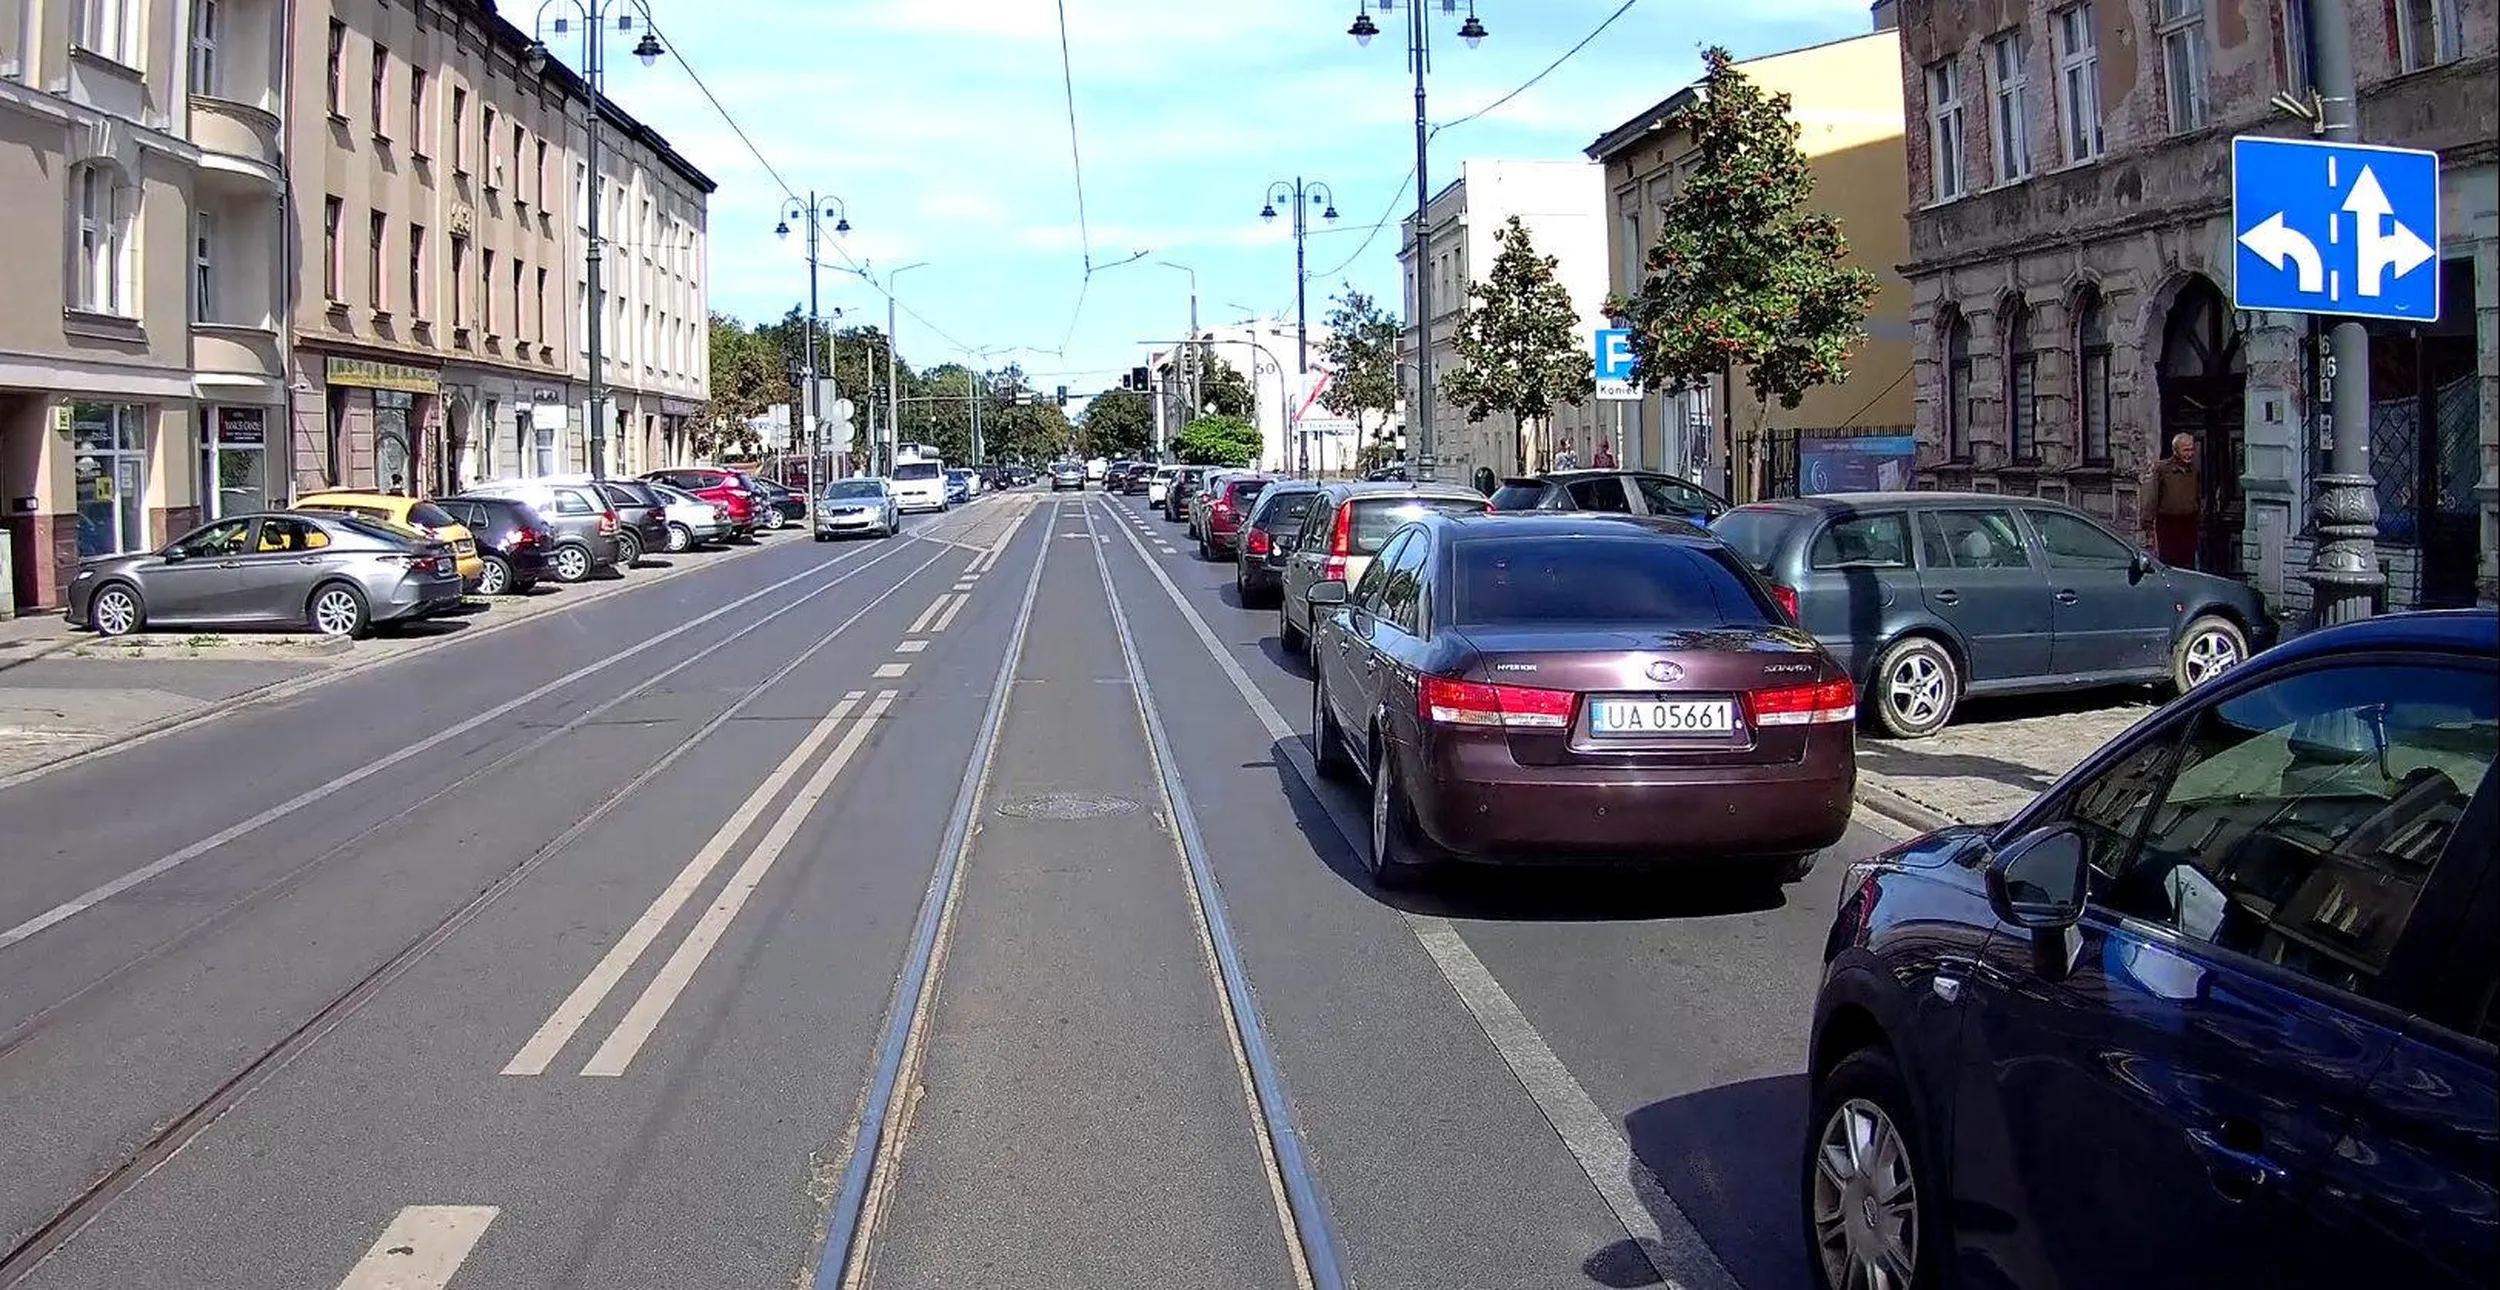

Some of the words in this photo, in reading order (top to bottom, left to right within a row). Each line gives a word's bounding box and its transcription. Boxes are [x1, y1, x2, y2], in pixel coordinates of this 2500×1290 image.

[1606, 335, 1635, 373] P
[1608, 705, 1643, 728] UA
[1653, 705, 1725, 728] 05661
